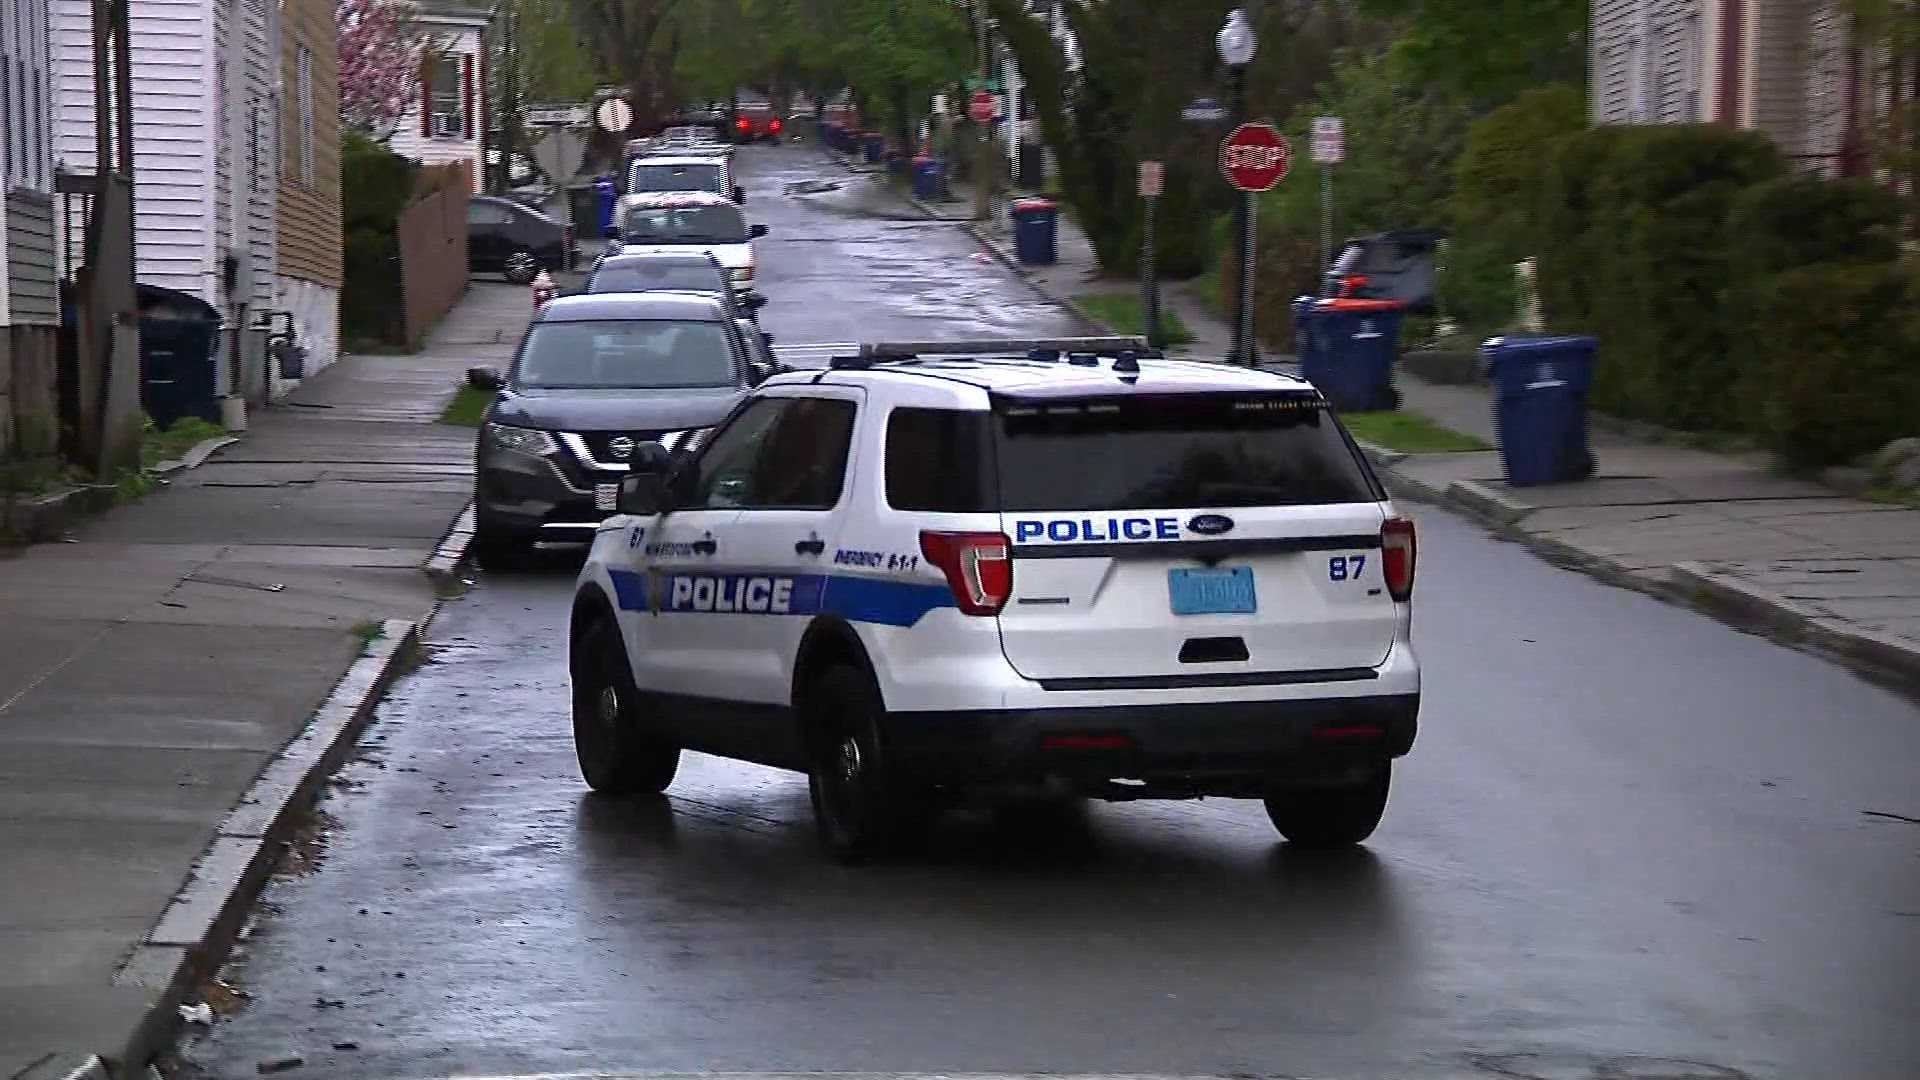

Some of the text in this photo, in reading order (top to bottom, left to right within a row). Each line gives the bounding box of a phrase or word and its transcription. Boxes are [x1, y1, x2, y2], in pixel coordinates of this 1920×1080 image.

[1225, 144, 1286, 170] STOP
[1016, 517, 1180, 542] POLICE
[1329, 554, 1366, 581] 87
[671, 576, 793, 614] POLICE
